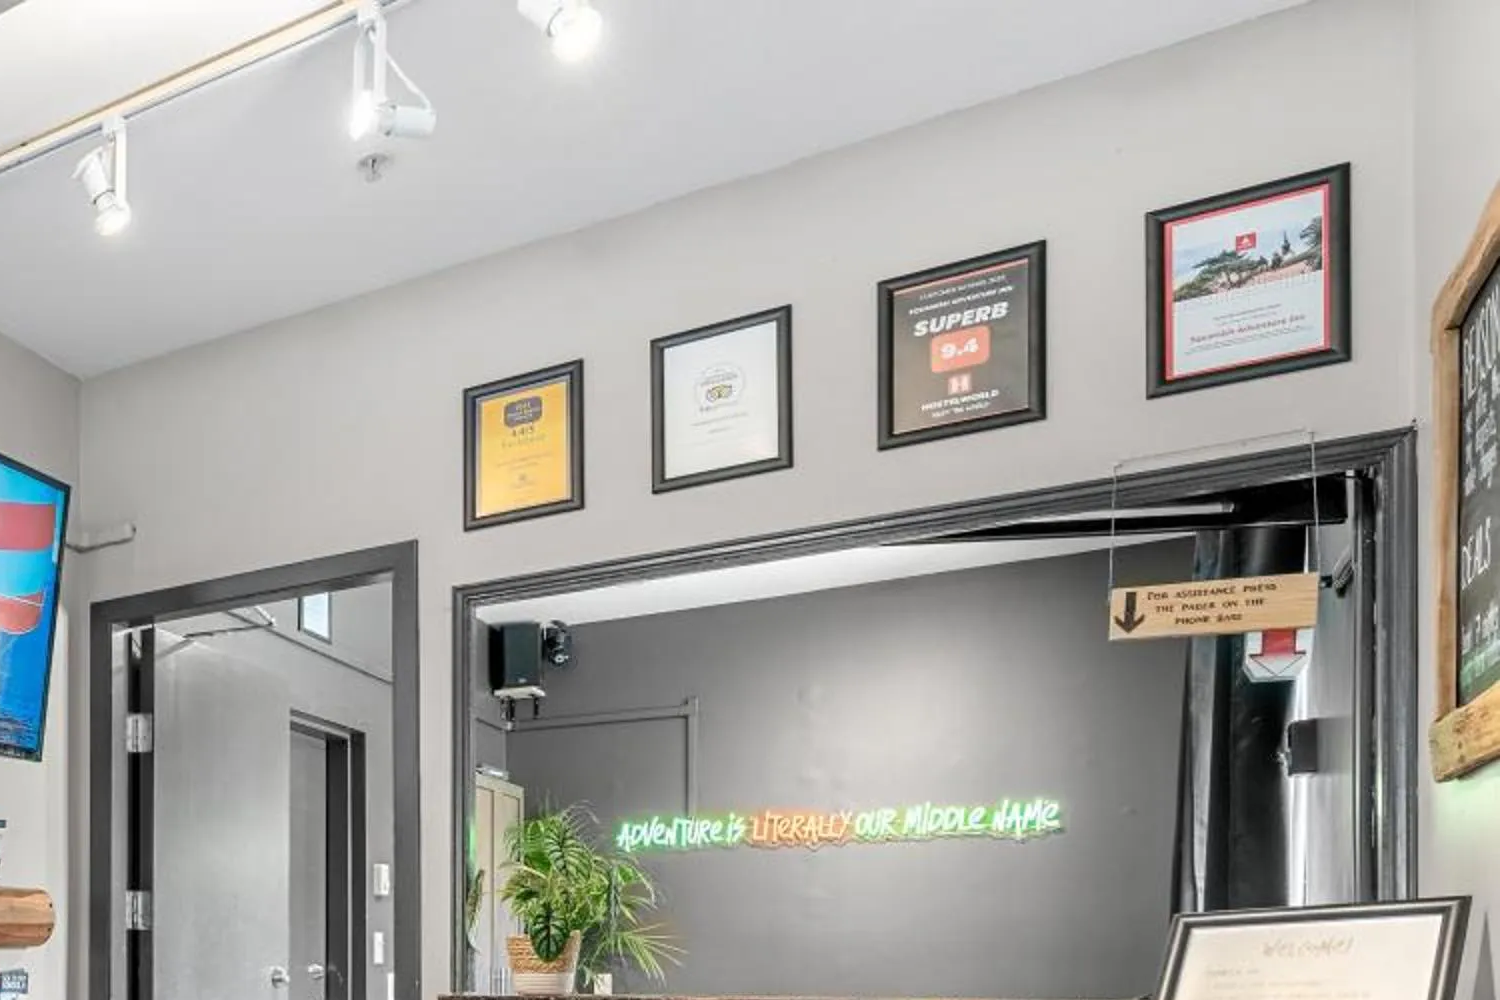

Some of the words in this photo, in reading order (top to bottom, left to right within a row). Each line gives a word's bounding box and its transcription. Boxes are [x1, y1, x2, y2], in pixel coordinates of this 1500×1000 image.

[913, 301, 1009, 337] SUPERB
[940, 337, 979, 360] 9.4
[1147, 591, 1169, 601] FOR
[1156, 604, 1174, 613] THE
[1222, 599, 1238, 609] ON
[855, 808, 901, 837] OUR
